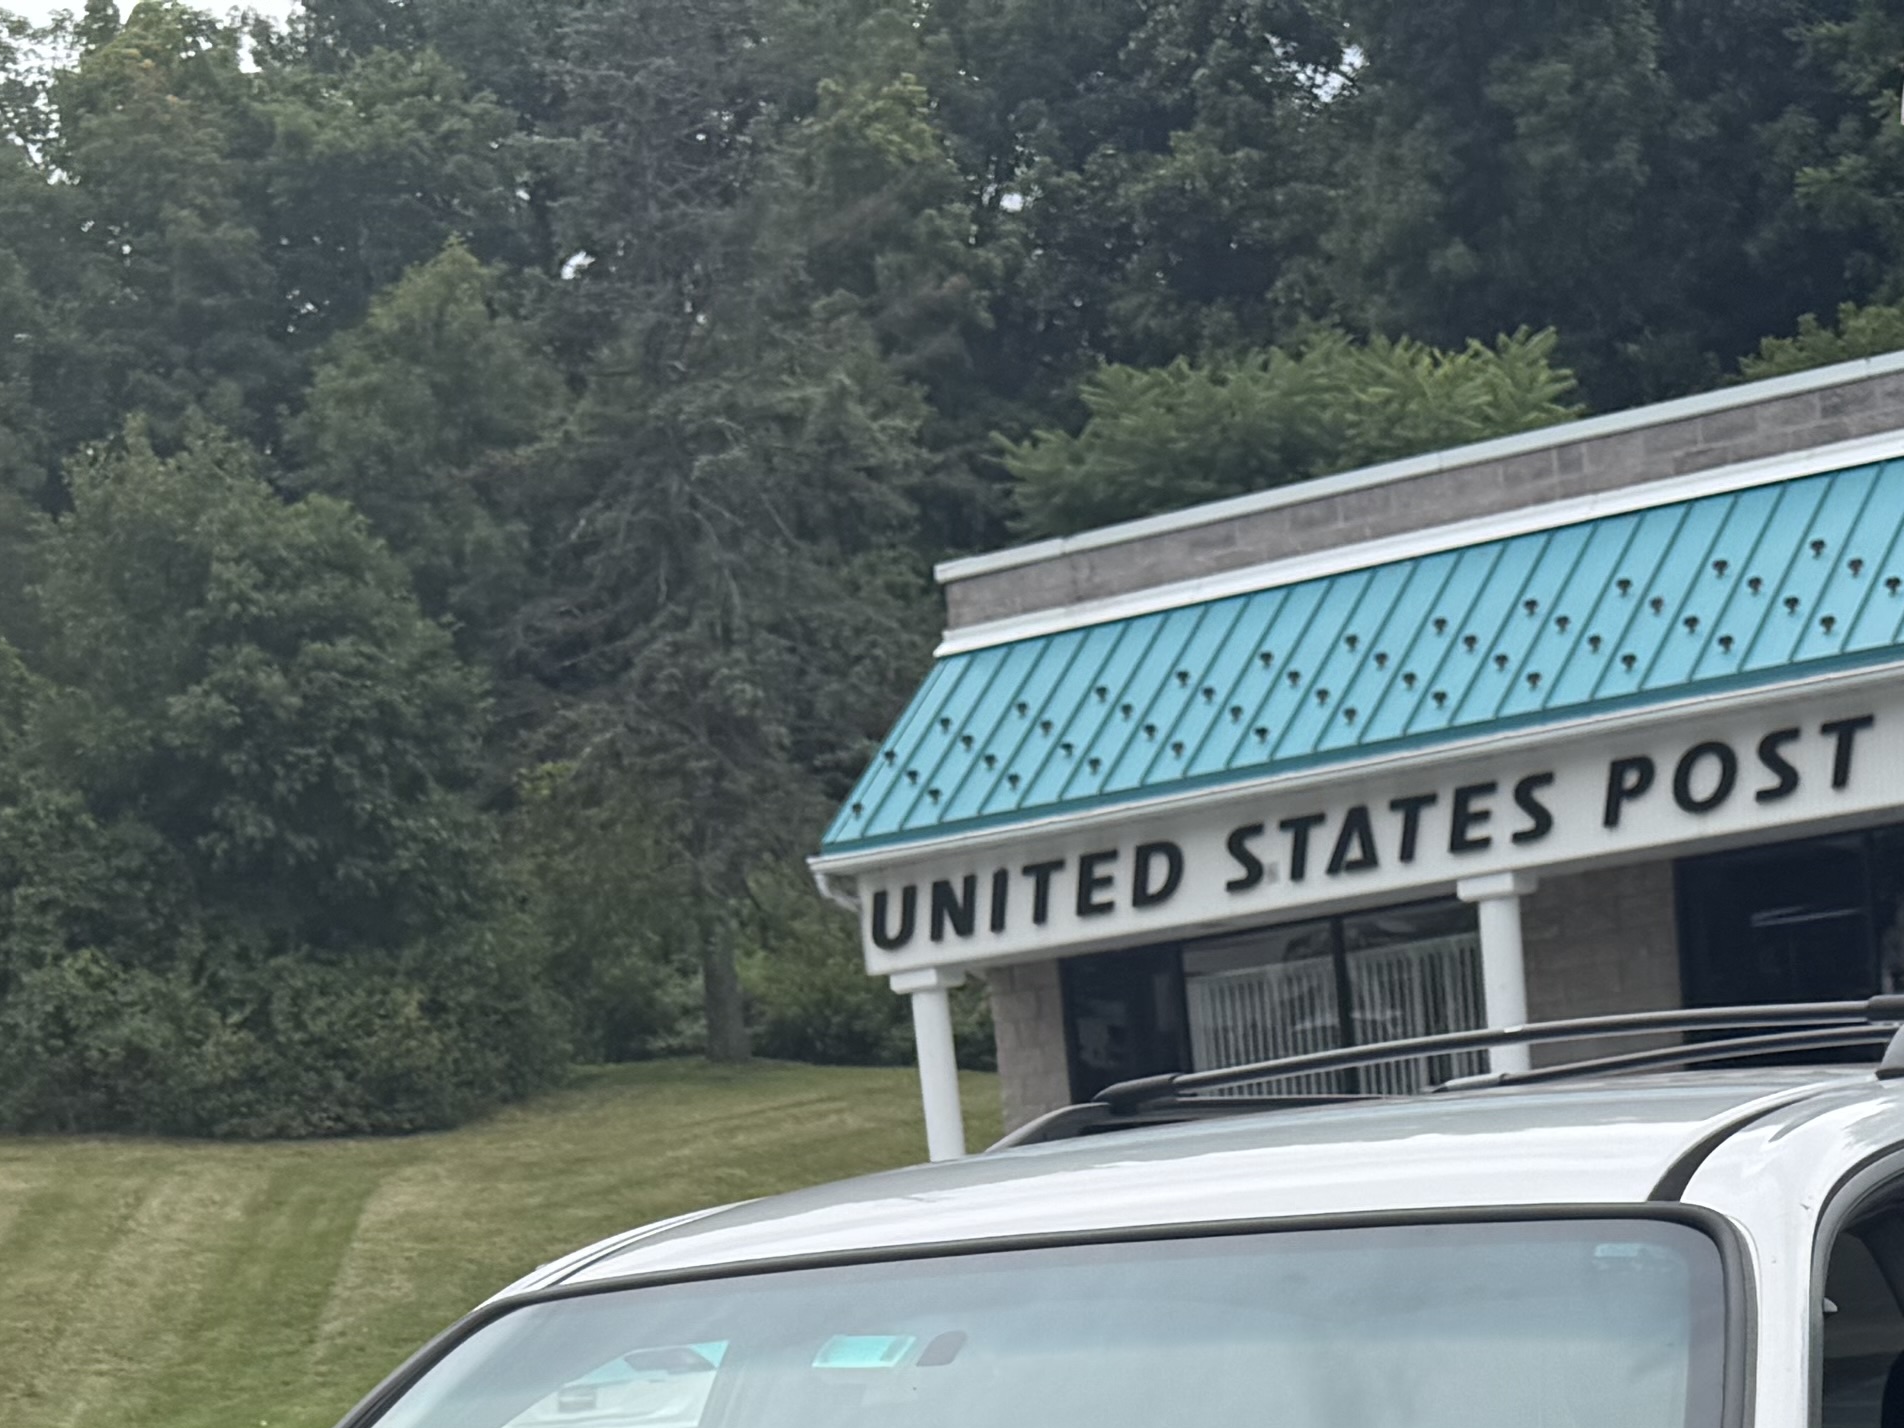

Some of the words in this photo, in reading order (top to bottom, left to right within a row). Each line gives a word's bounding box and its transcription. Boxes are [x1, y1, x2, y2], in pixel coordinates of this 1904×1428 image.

[871, 841, 1186, 950] UNITED
[1225, 771, 1555, 892] STATES
[1602, 714, 1876, 828] POST
